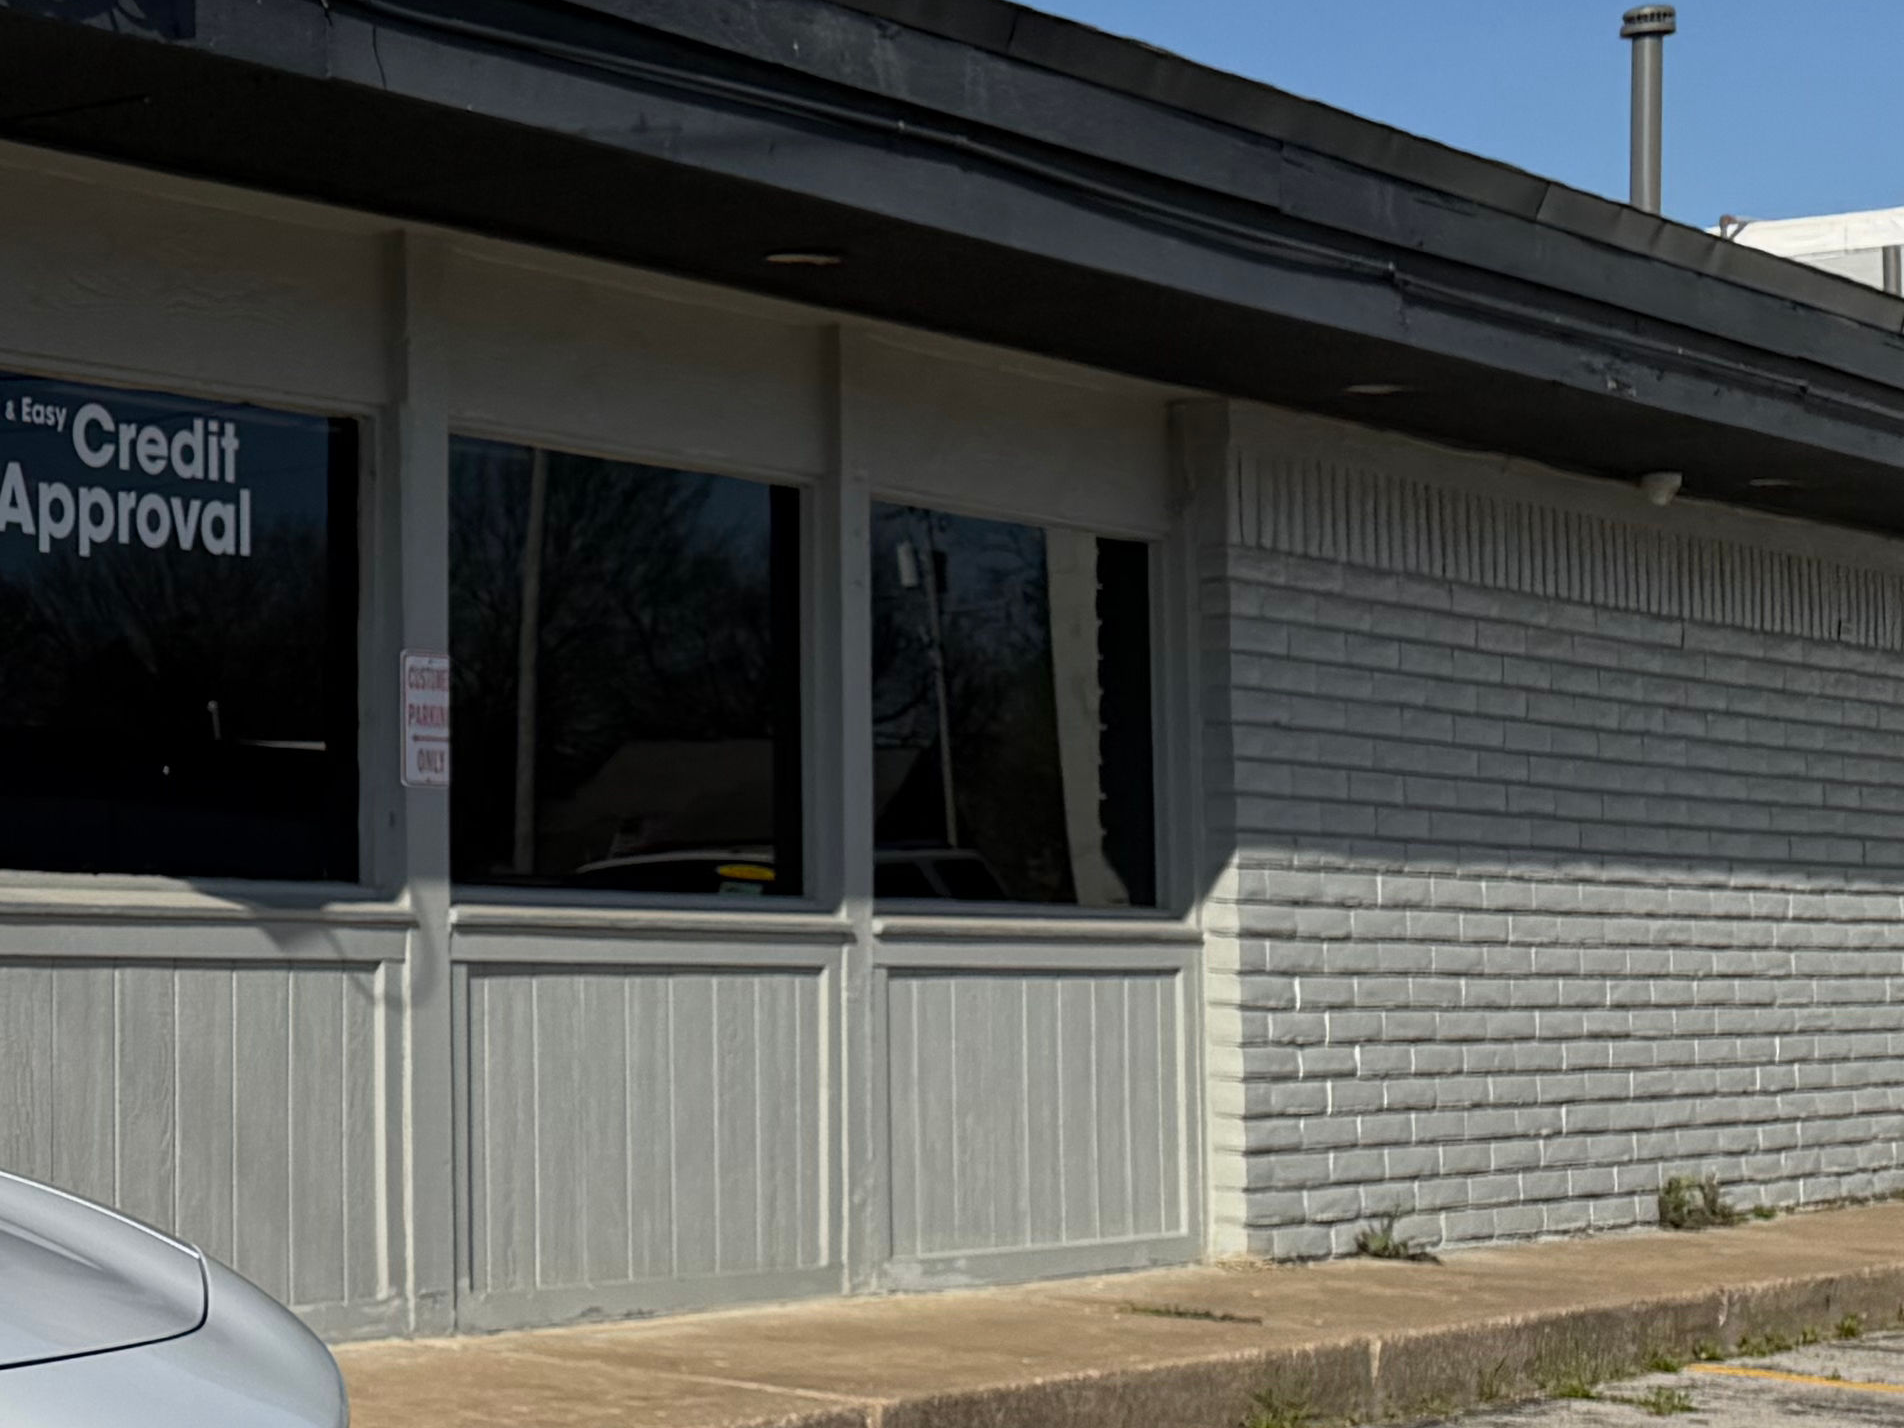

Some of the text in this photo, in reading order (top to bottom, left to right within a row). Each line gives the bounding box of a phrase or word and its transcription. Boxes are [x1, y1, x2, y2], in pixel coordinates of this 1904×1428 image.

[5, 400, 16, 420] &
[22, 397, 67, 432] Easy
[72, 403, 239, 483] Credit
[408, 664, 449, 691] CUSTOME
[408, 703, 449, 728] PARKIN
[417, 748, 445, 774] ONLY
